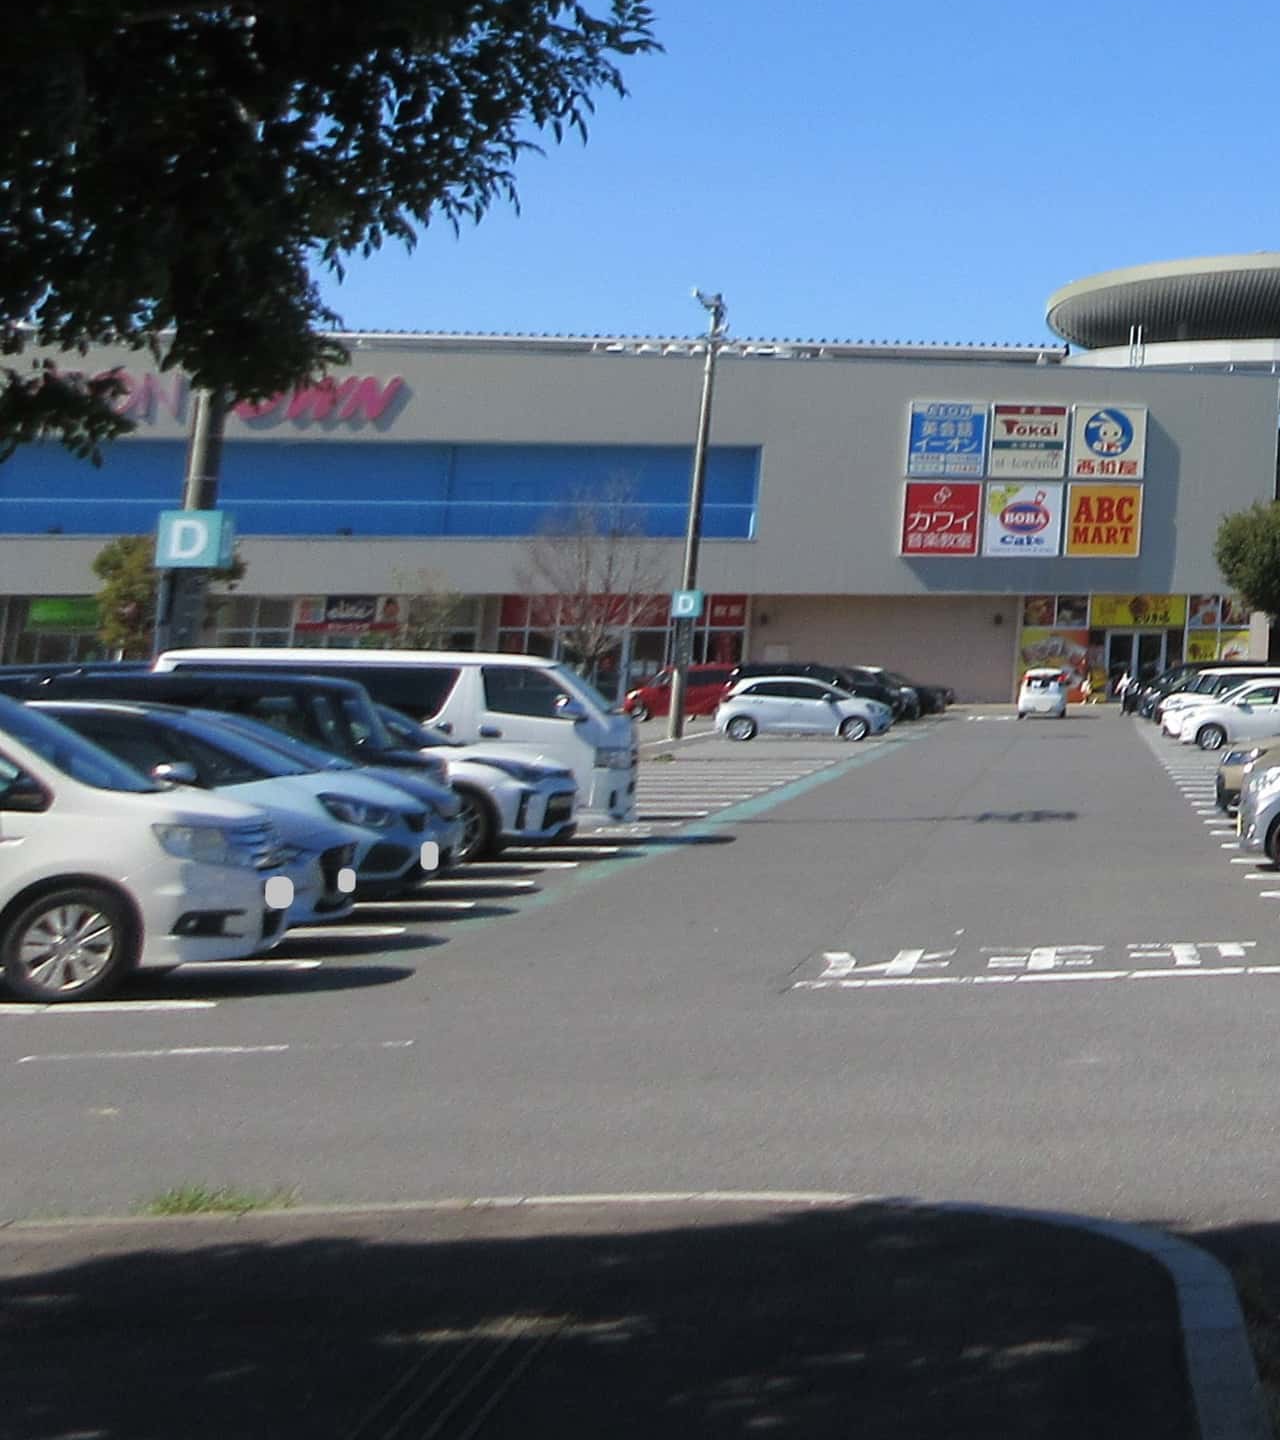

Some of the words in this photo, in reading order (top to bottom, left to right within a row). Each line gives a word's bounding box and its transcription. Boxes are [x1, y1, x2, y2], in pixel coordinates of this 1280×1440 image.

[914, 438, 978, 453] イーオン
[1003, 511, 1047, 526] BOBA
[1073, 496, 1134, 524] ABC
[908, 511, 974, 532] カワイ
[169, 519, 208, 559] D
[1072, 527, 1133, 545] MART
[678, 595, 694, 614] D
